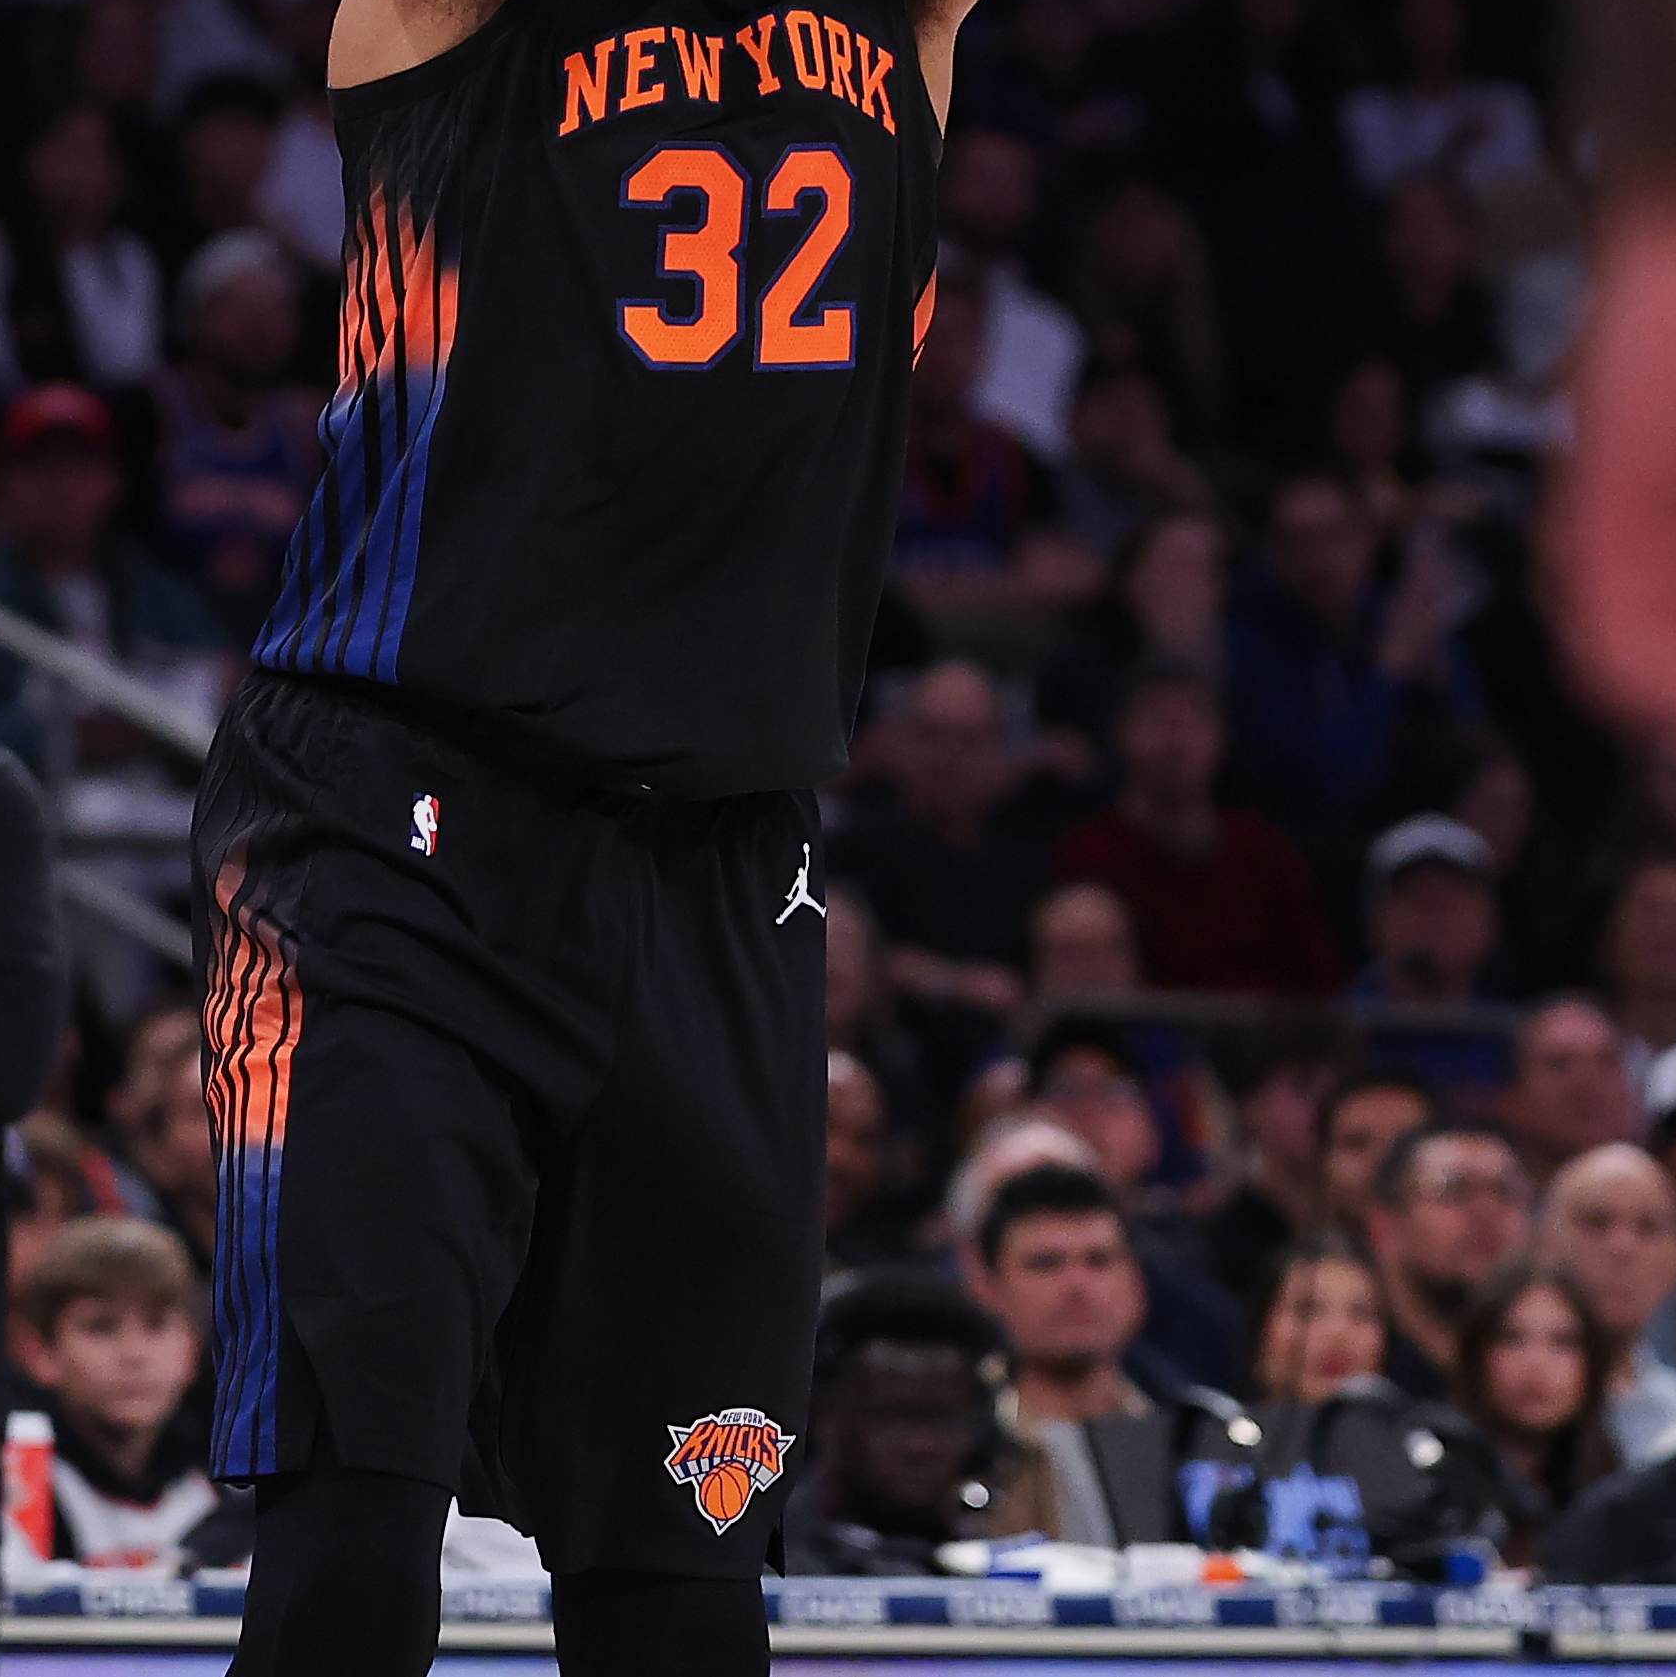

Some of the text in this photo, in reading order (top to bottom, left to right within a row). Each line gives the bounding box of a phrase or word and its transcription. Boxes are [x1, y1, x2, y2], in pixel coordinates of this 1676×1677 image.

[558, 9, 897, 137] NEW YORK
[617, 141, 857, 372] 32
[668, 1421, 781, 1475] KNICKS
[719, 1410, 764, 1425] NEW YORK
